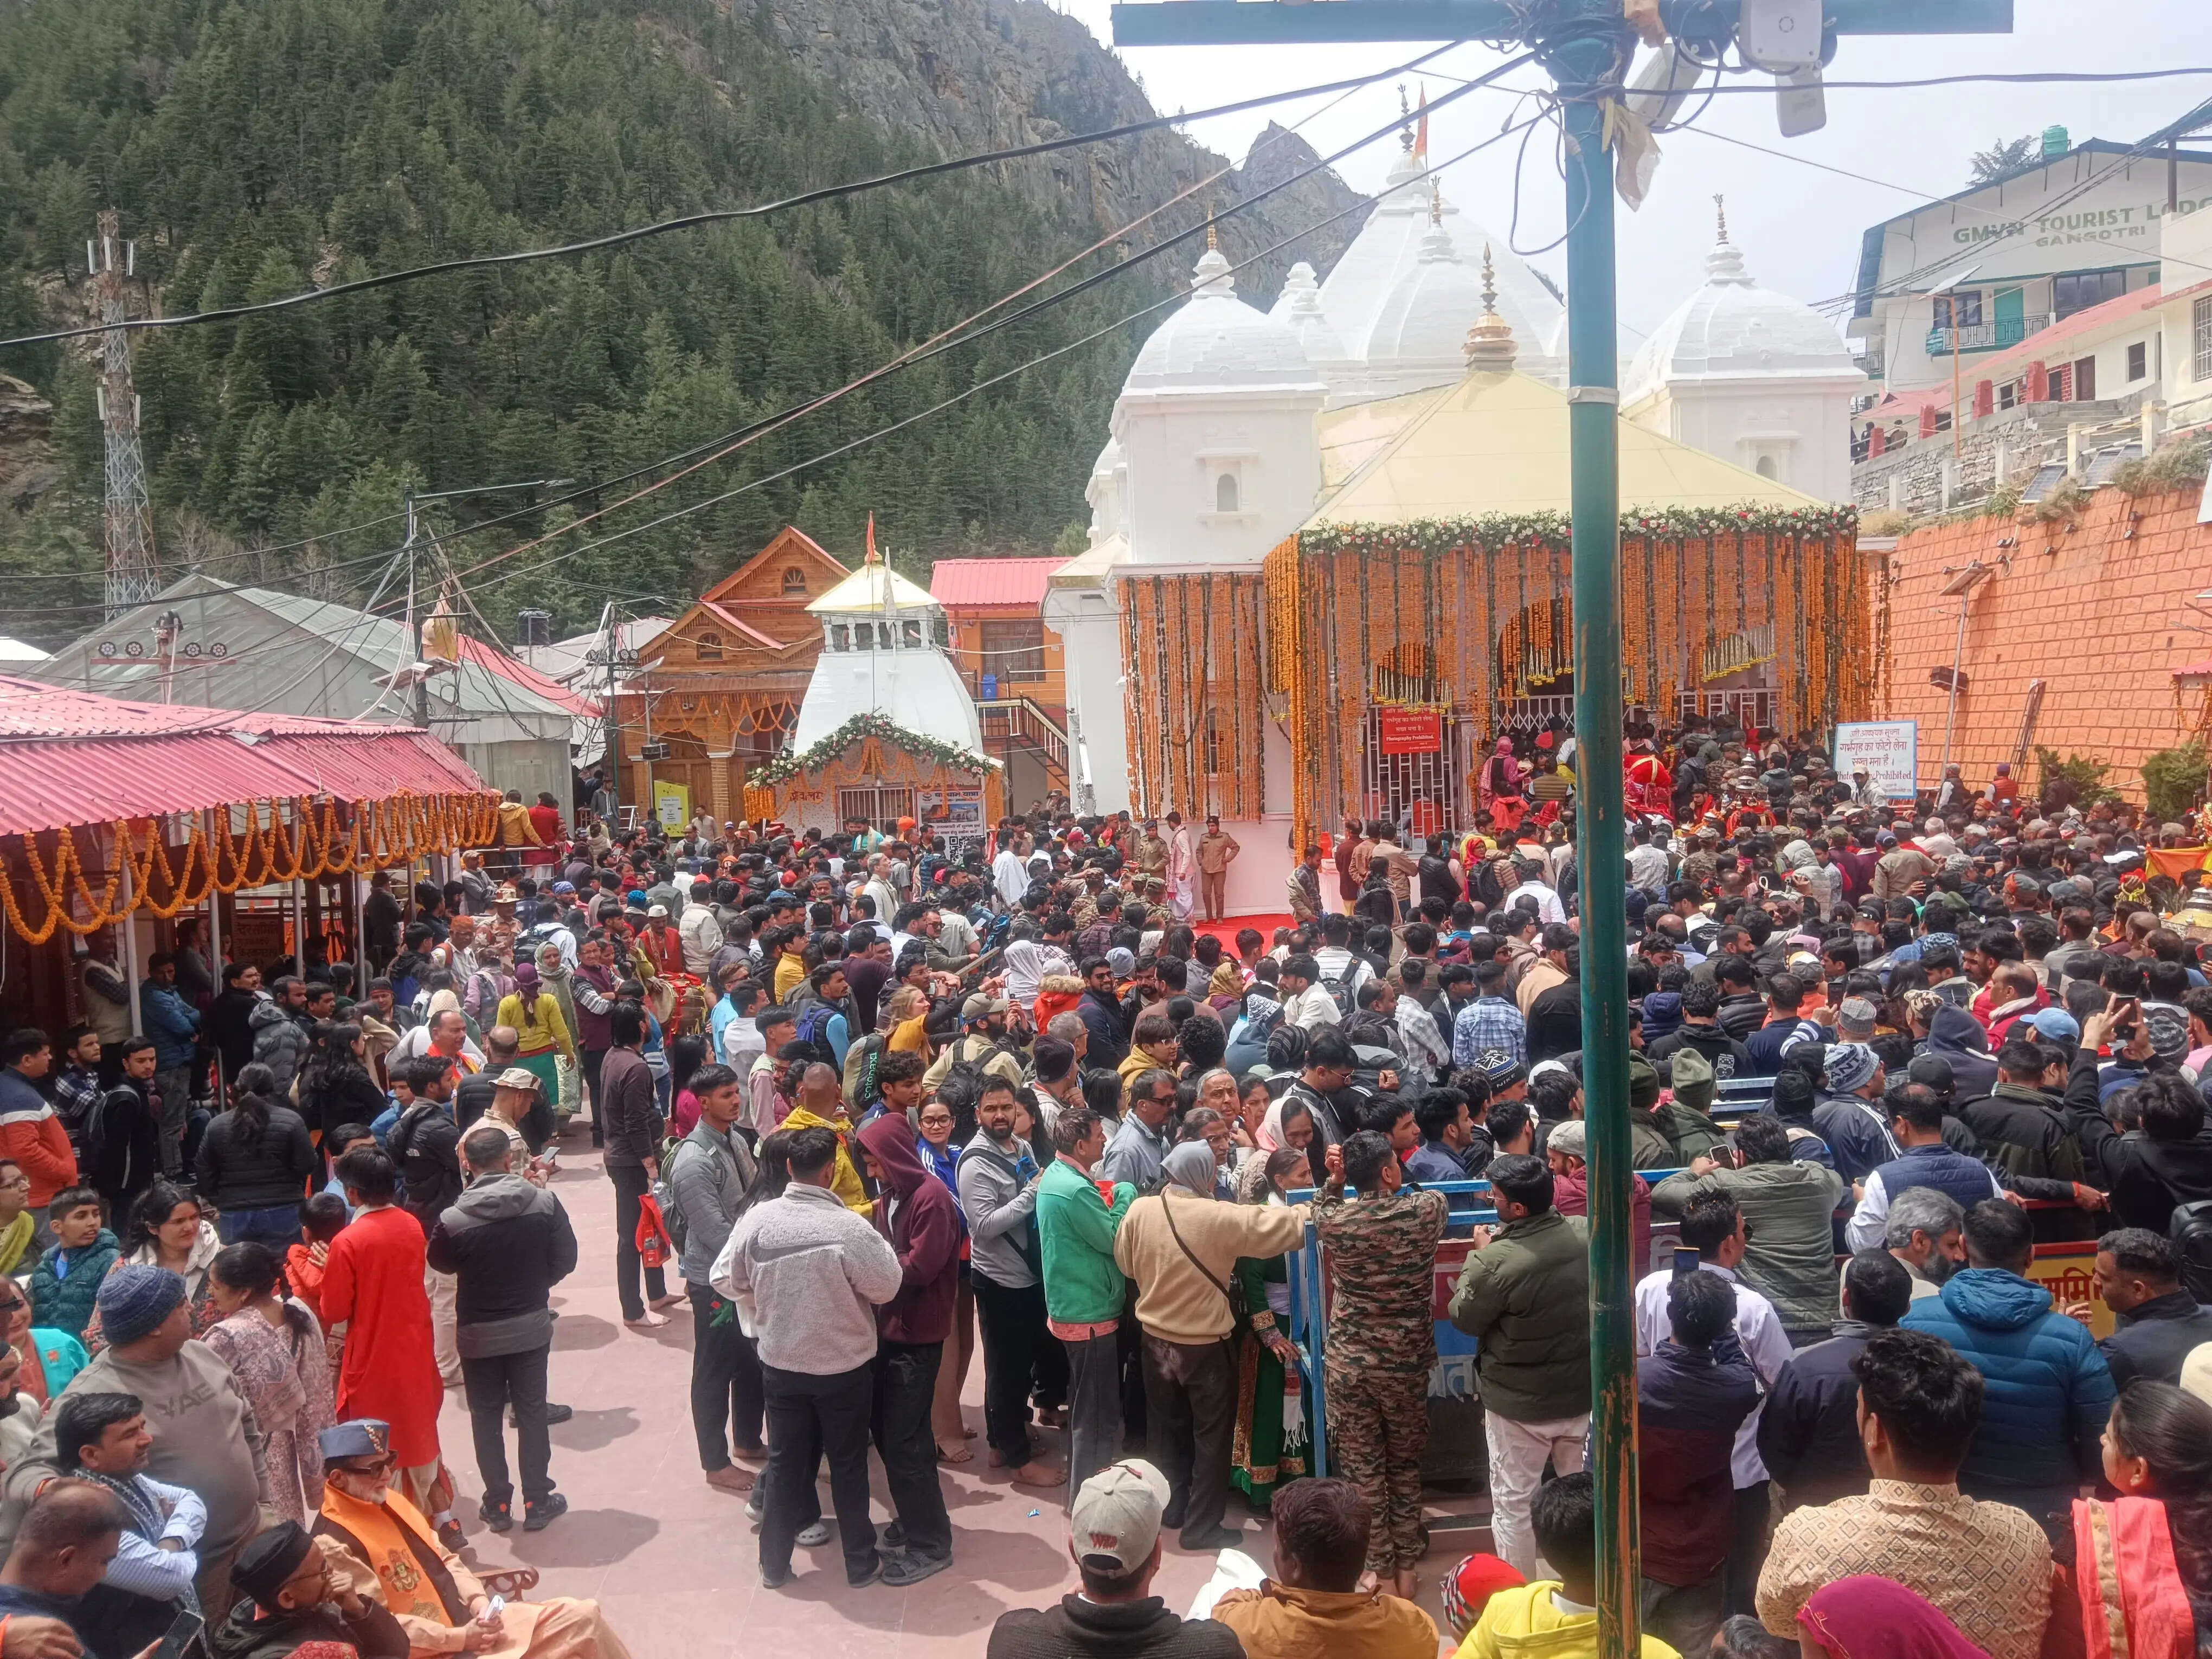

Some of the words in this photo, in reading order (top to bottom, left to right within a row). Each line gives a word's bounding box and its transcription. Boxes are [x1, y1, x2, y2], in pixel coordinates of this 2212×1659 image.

[1953, 221, 2024, 243] GMVN
[2039, 207, 2134, 233] TOURIST
[2035, 226, 2146, 247] GANGOTRI
[1864, 742, 1874, 751] का
[1893, 738, 1907, 751] लेना
[1869, 757, 1882, 767] मना
[1875, 770, 1913, 781] Prohibited.
[1496, 1073, 1516, 1089] NIKE
